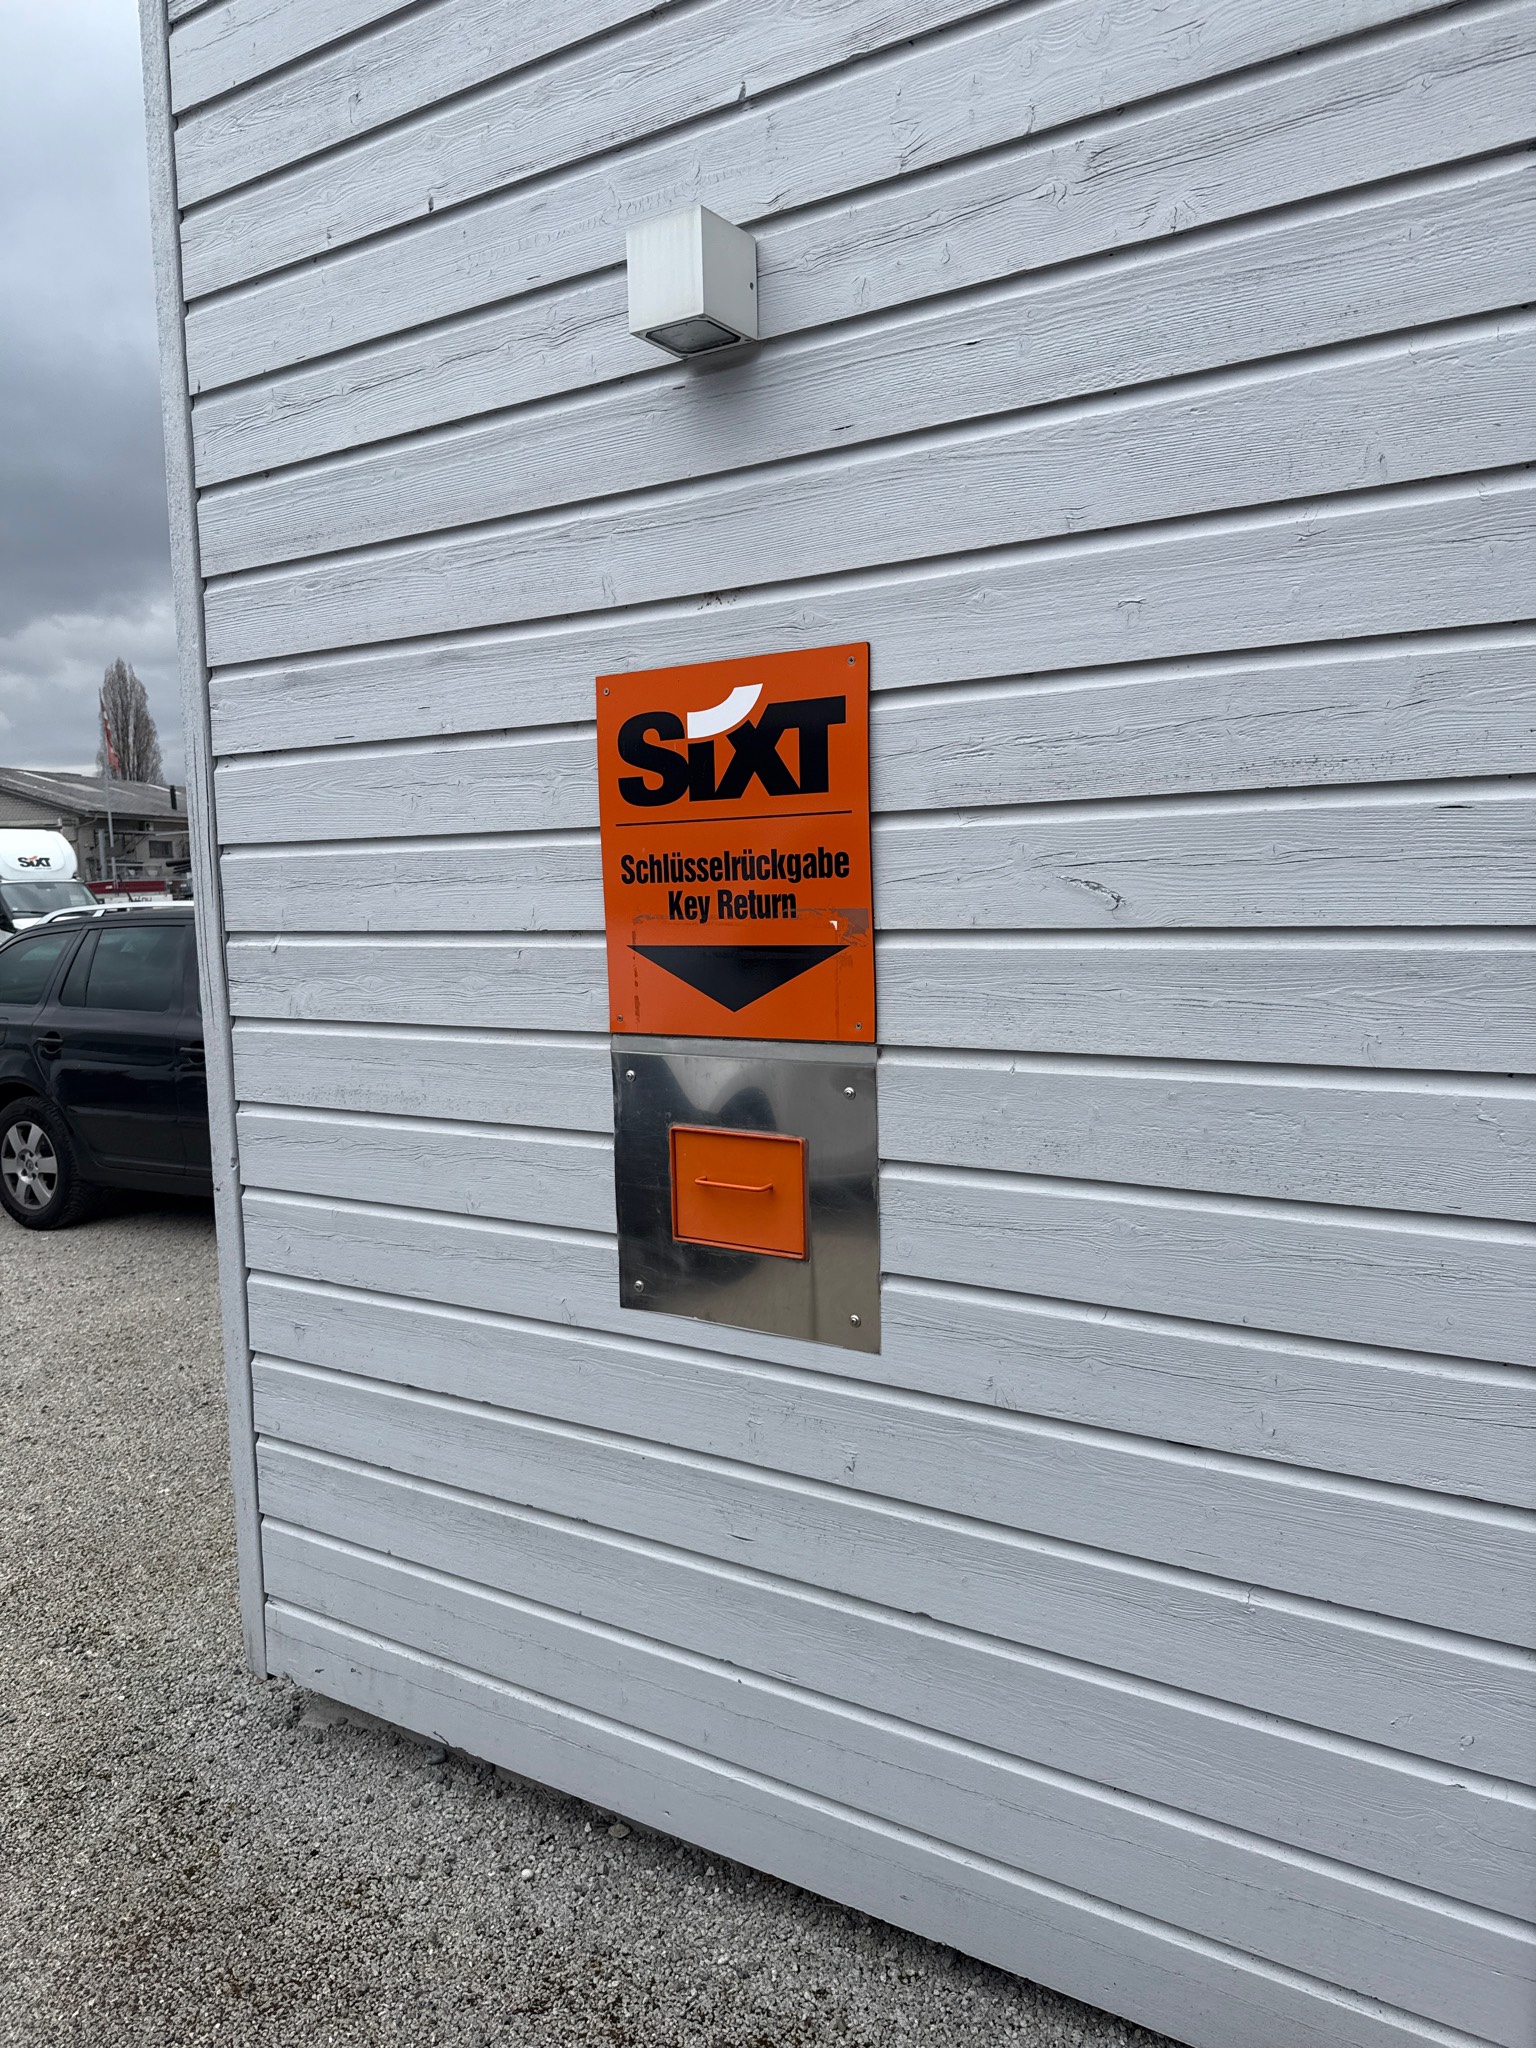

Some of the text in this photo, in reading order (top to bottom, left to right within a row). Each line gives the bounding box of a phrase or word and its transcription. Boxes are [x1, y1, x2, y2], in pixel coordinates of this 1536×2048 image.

[620, 846, 850, 885] Schlüsselrückgabe
[668, 889, 797, 924] Key Return
